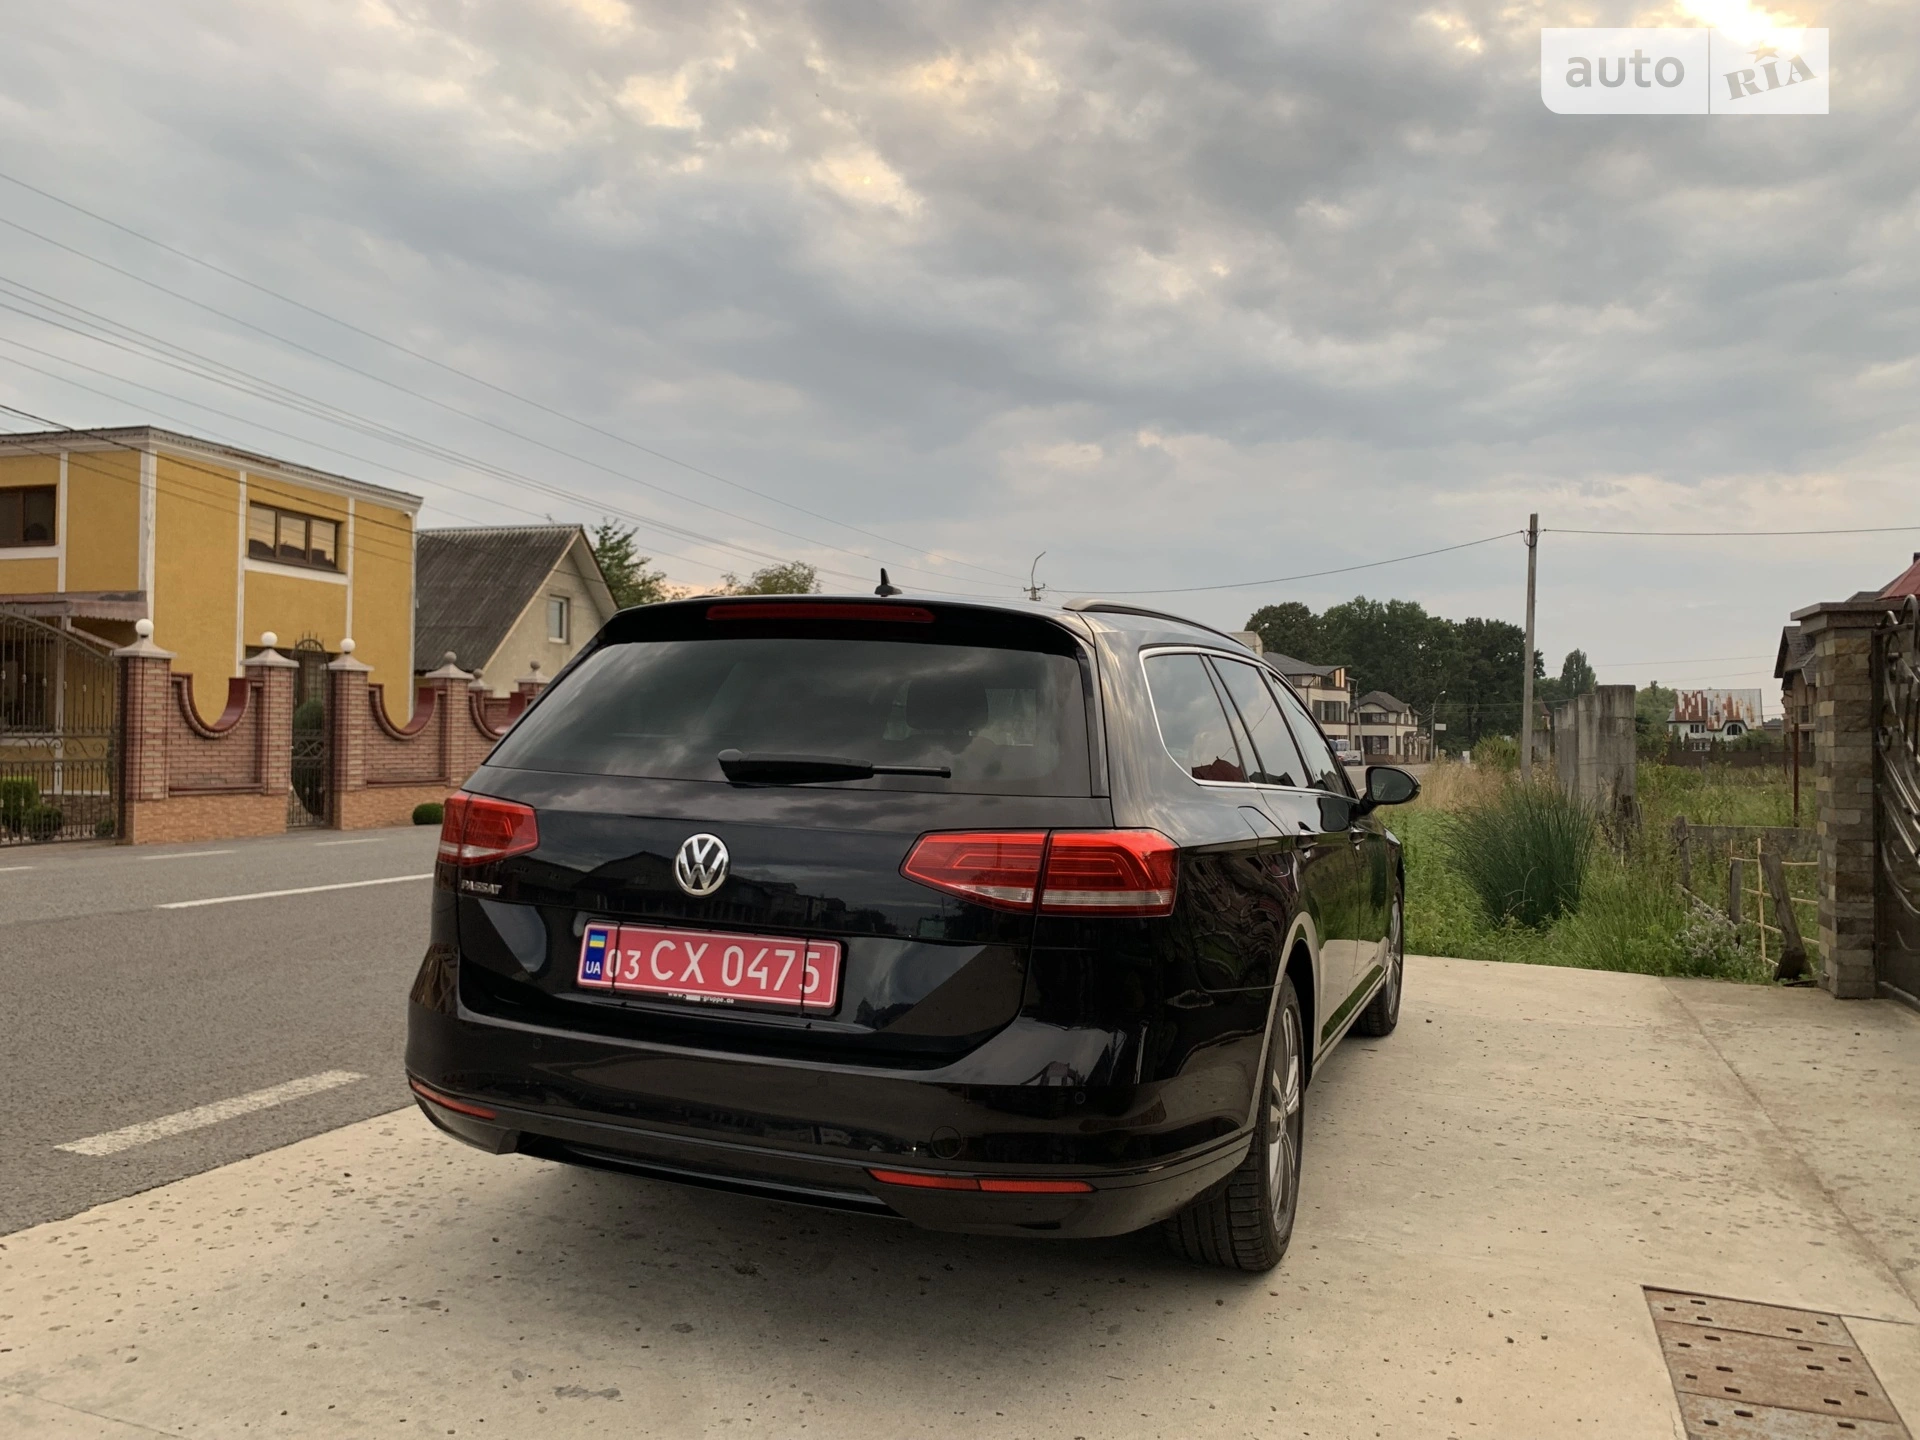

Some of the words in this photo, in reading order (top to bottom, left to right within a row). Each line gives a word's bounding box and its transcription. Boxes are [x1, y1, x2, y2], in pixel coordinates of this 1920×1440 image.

[675, 833, 729, 896] VW
[461, 879, 502, 895] PASSAT
[585, 960, 601, 975] UA
[605, 948, 642, 980] 03
[651, 939, 710, 984] CX
[721, 945, 821, 994] 0475
